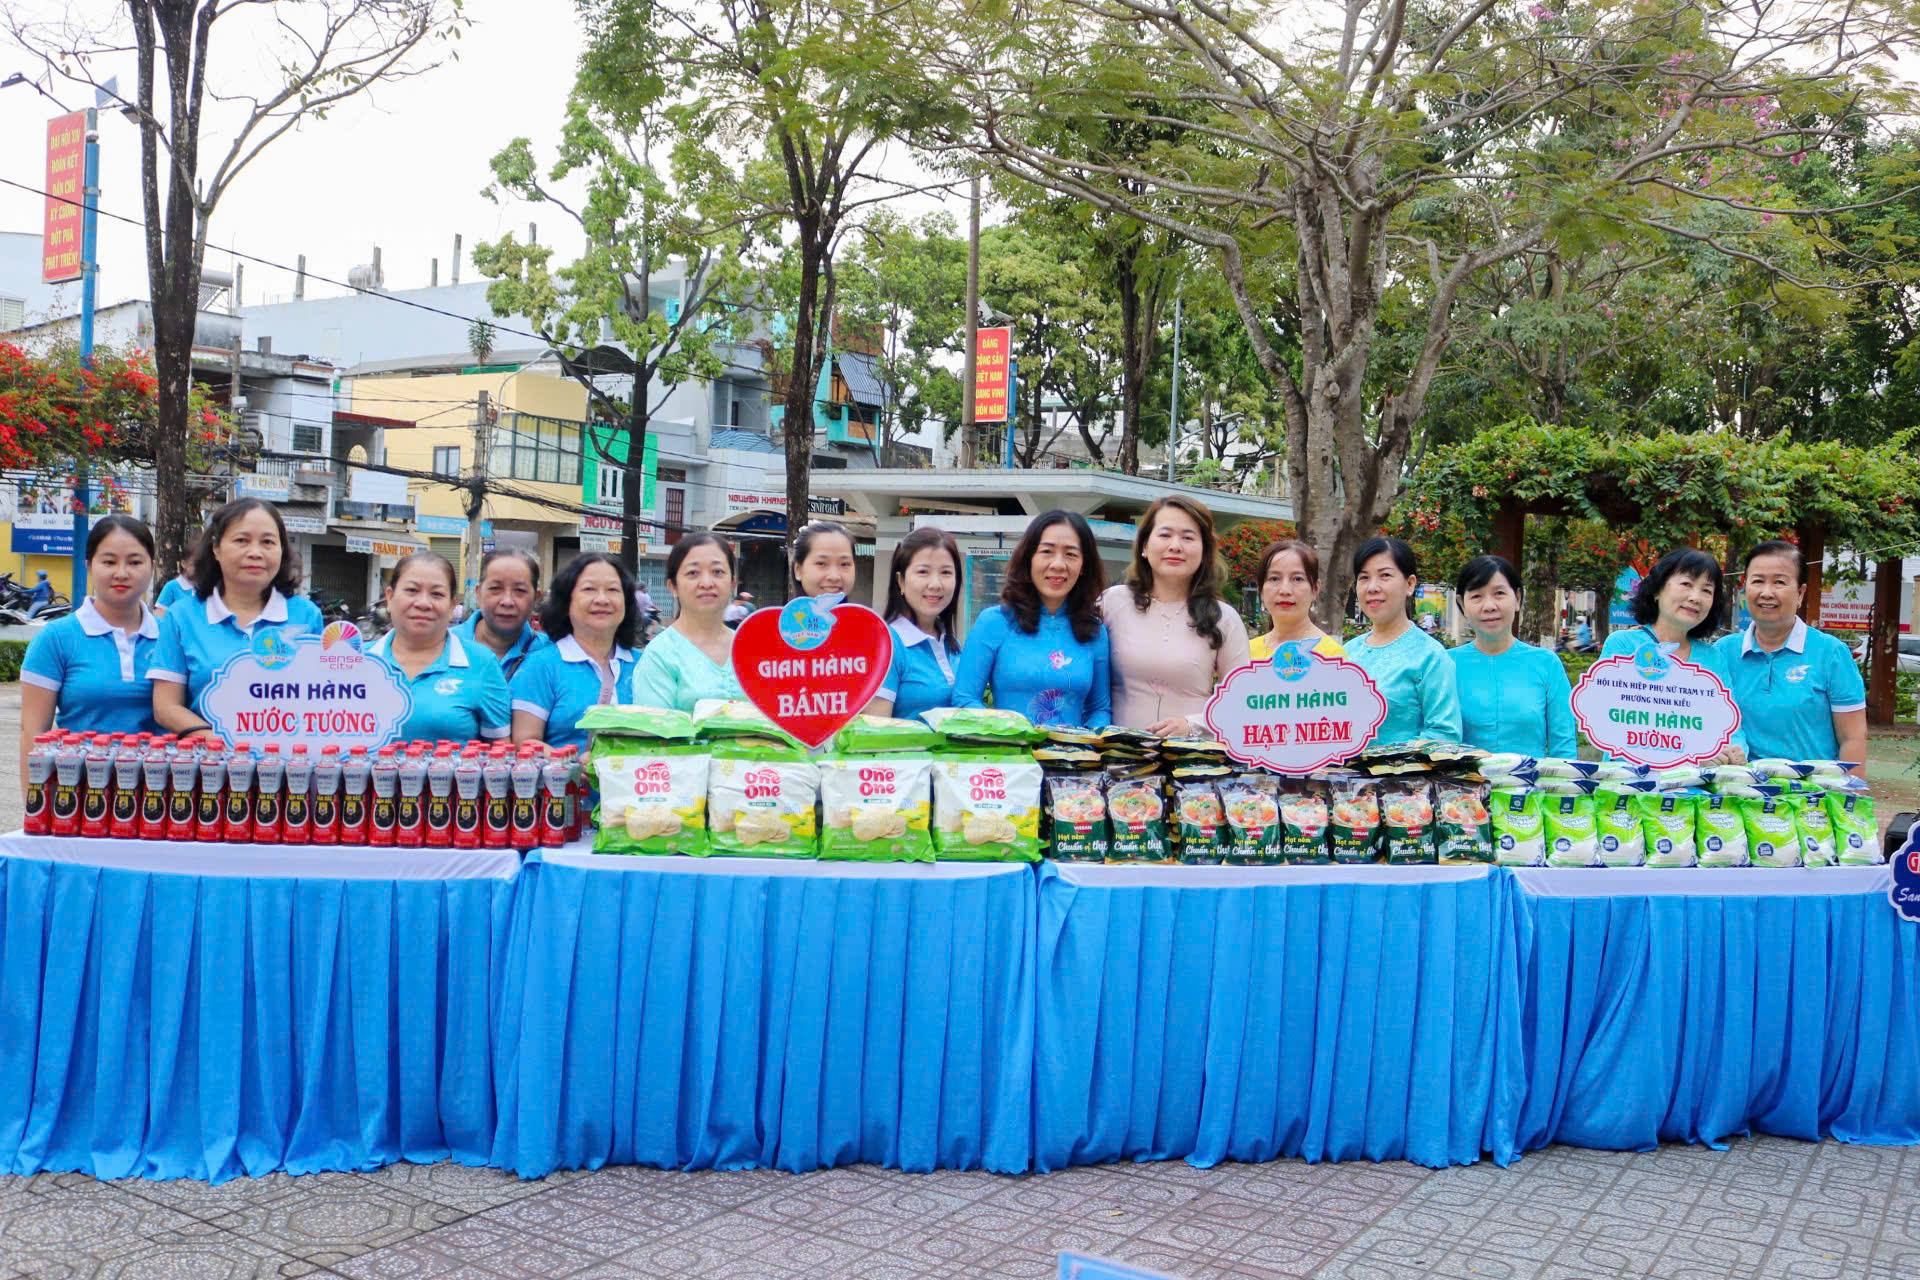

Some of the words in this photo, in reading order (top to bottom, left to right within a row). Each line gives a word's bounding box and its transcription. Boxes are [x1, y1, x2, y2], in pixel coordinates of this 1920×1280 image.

[758, 658, 806, 678] GIAN
[812, 654, 866, 676] HÀNG
[249, 683, 299, 700] GIAN
[308, 680, 366, 700] HÀNG
[1596, 678, 1610, 688] HỘI
[1612, 680, 1628, 689] LIÊN
[1630, 682, 1647, 691] HIỆP
[1649, 684, 1664, 693] PHỤ
[1679, 688, 1698, 696] TRẠM
[1706, 688, 1715, 698] TẾ
[778, 687, 848, 717] BÁNH
[1246, 693, 1290, 710] GIAN
[1296, 689, 1348, 709] HÀNG
[1620, 694, 1651, 704] PHƯỜNG
[1653, 698, 1672, 706] NINH
[236, 707, 296, 733] NƯỚC
[304, 709, 376, 734] TƯƠNG
[1609, 708, 1649, 726] GIAN
[1655, 711, 1702, 730] HÀNG
[1243, 724, 1288, 748] HẠT
[1295, 716, 1352, 742] NIÊM
[1627, 730, 1682, 750] ĐƯỜNG
[634, 768, 671, 781] One
[744, 772, 781, 784] One
[859, 767, 896, 782] One
[969, 775, 1006, 788] One
[634, 782, 671, 796] One
[744, 785, 781, 799] One
[859, 782, 896, 796] One
[969, 788, 1006, 801] One
